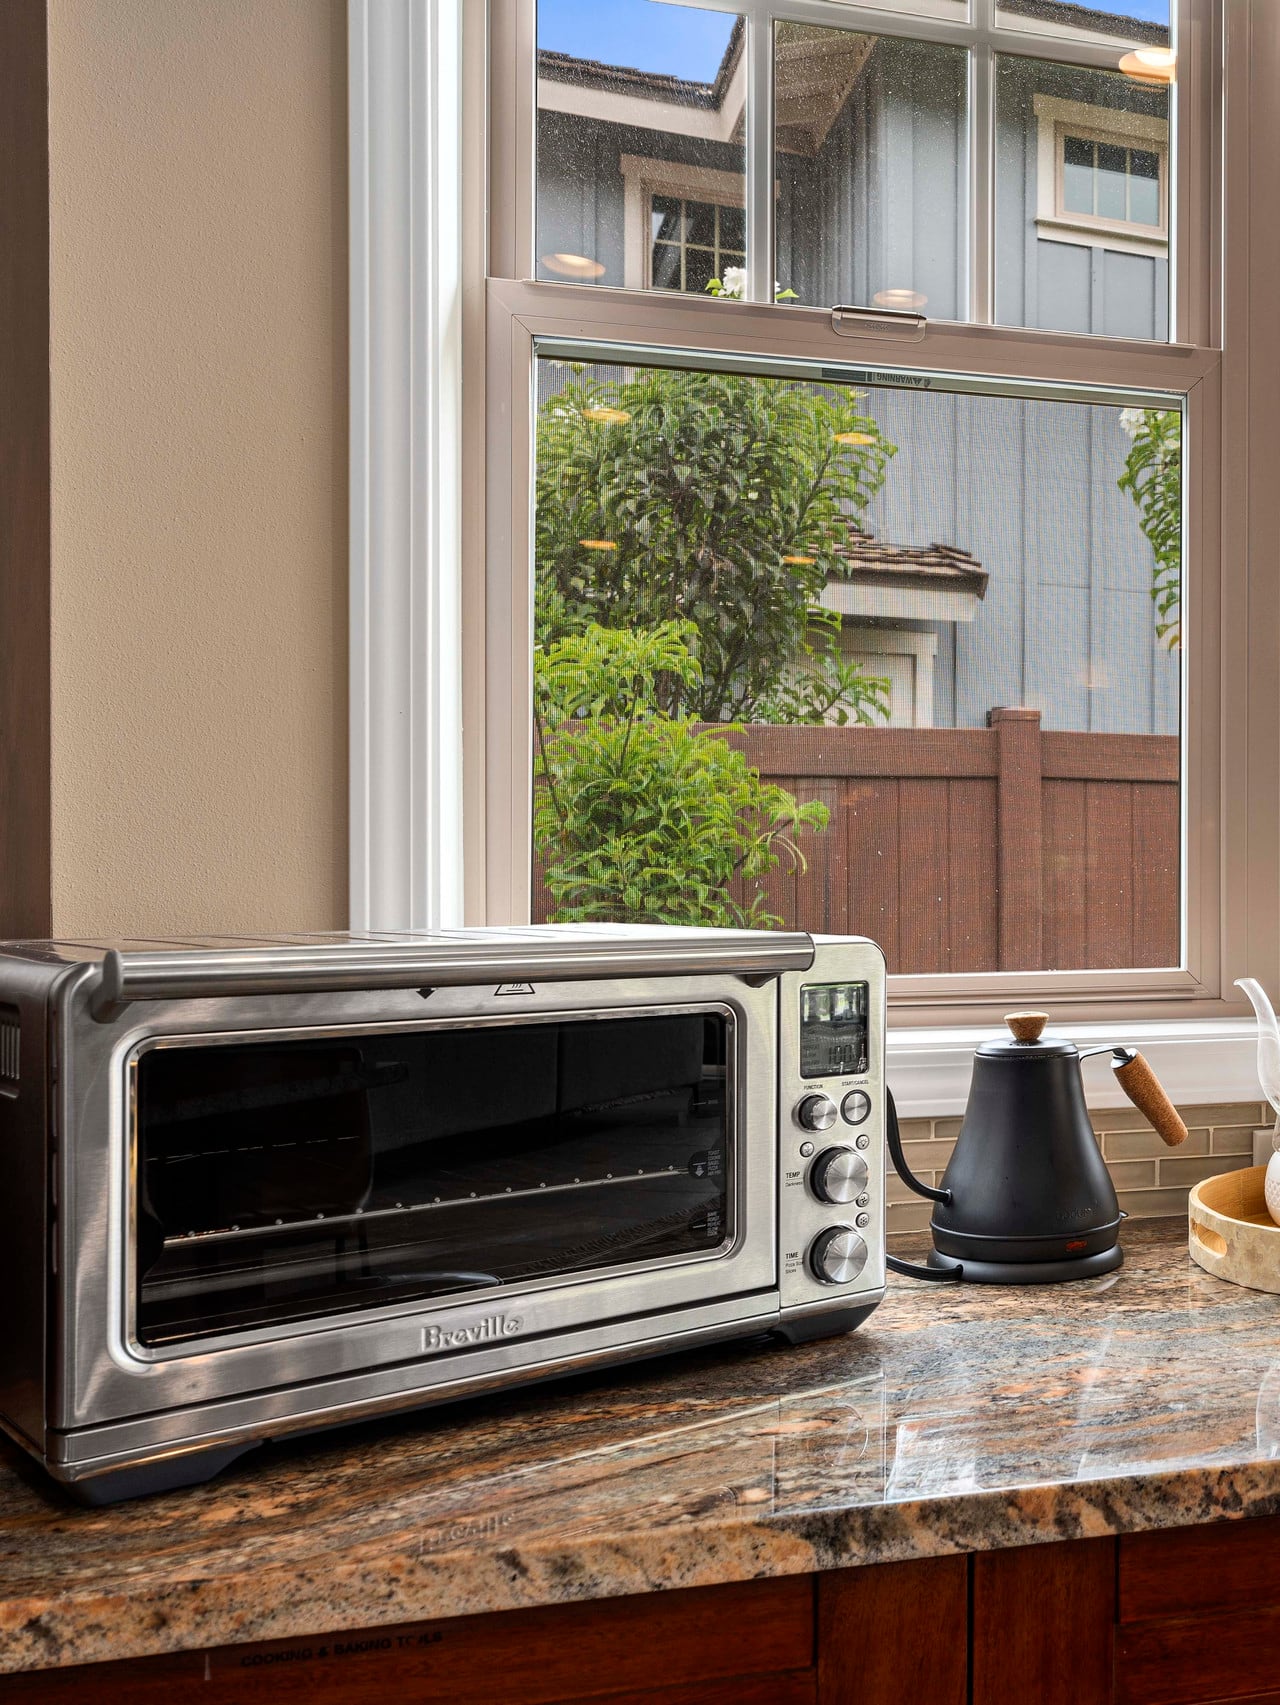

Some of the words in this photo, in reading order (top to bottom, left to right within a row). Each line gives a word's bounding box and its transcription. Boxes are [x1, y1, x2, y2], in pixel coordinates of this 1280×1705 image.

[876, 373, 912, 385] WARNING
[785, 1171, 801, 1179] TEMP
[785, 1251, 799, 1260] TIME
[420, 1314, 521, 1352] Breville
[241, 1647, 314, 1668] COOKING
[318, 1645, 330, 1658] &
[334, 1638, 392, 1656] BAKING
